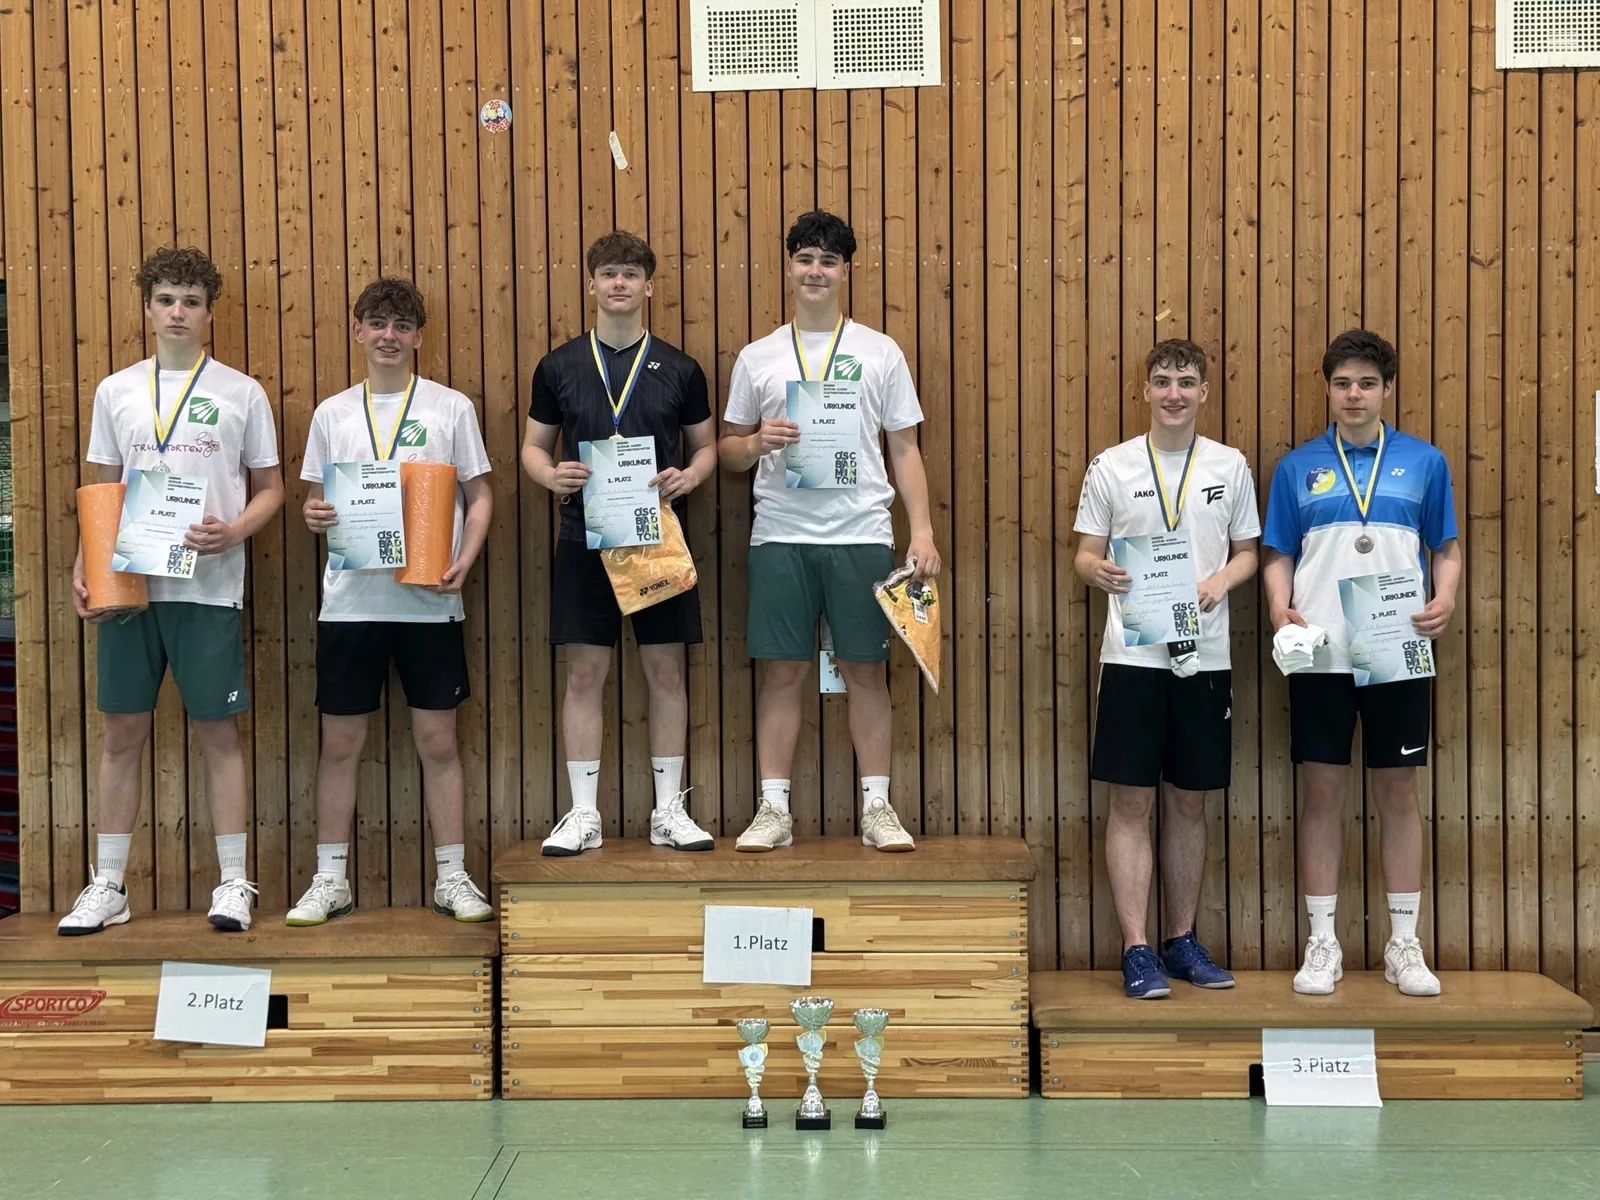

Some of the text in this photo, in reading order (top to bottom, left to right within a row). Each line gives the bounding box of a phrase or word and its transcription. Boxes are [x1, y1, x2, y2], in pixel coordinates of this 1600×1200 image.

[132, 444, 203, 453] TRAUTORTEN
[618, 459, 652, 467] URKUNDE
[835, 477, 857, 485] TON
[1133, 489, 1155, 498] JAKO
[165, 495, 202, 505] URKUNDE
[637, 532, 660, 541] TON
[380, 556, 403, 564] TON
[1153, 552, 1189, 562] URKUNDE
[167, 566, 190, 575] TON
[1150, 571, 1168, 579] PLATZ
[650, 579, 670, 591] YONEX
[1381, 590, 1418, 602] URKUNDE
[1378, 610, 1397, 618] PLATZ
[1176, 628, 1200, 637] TON
[1407, 665, 1432, 676] TON
[733, 935, 788, 951] 1.Platz
[10, 997, 87, 1012] SPORTCO
[187, 992, 244, 1011] 2.Platz
